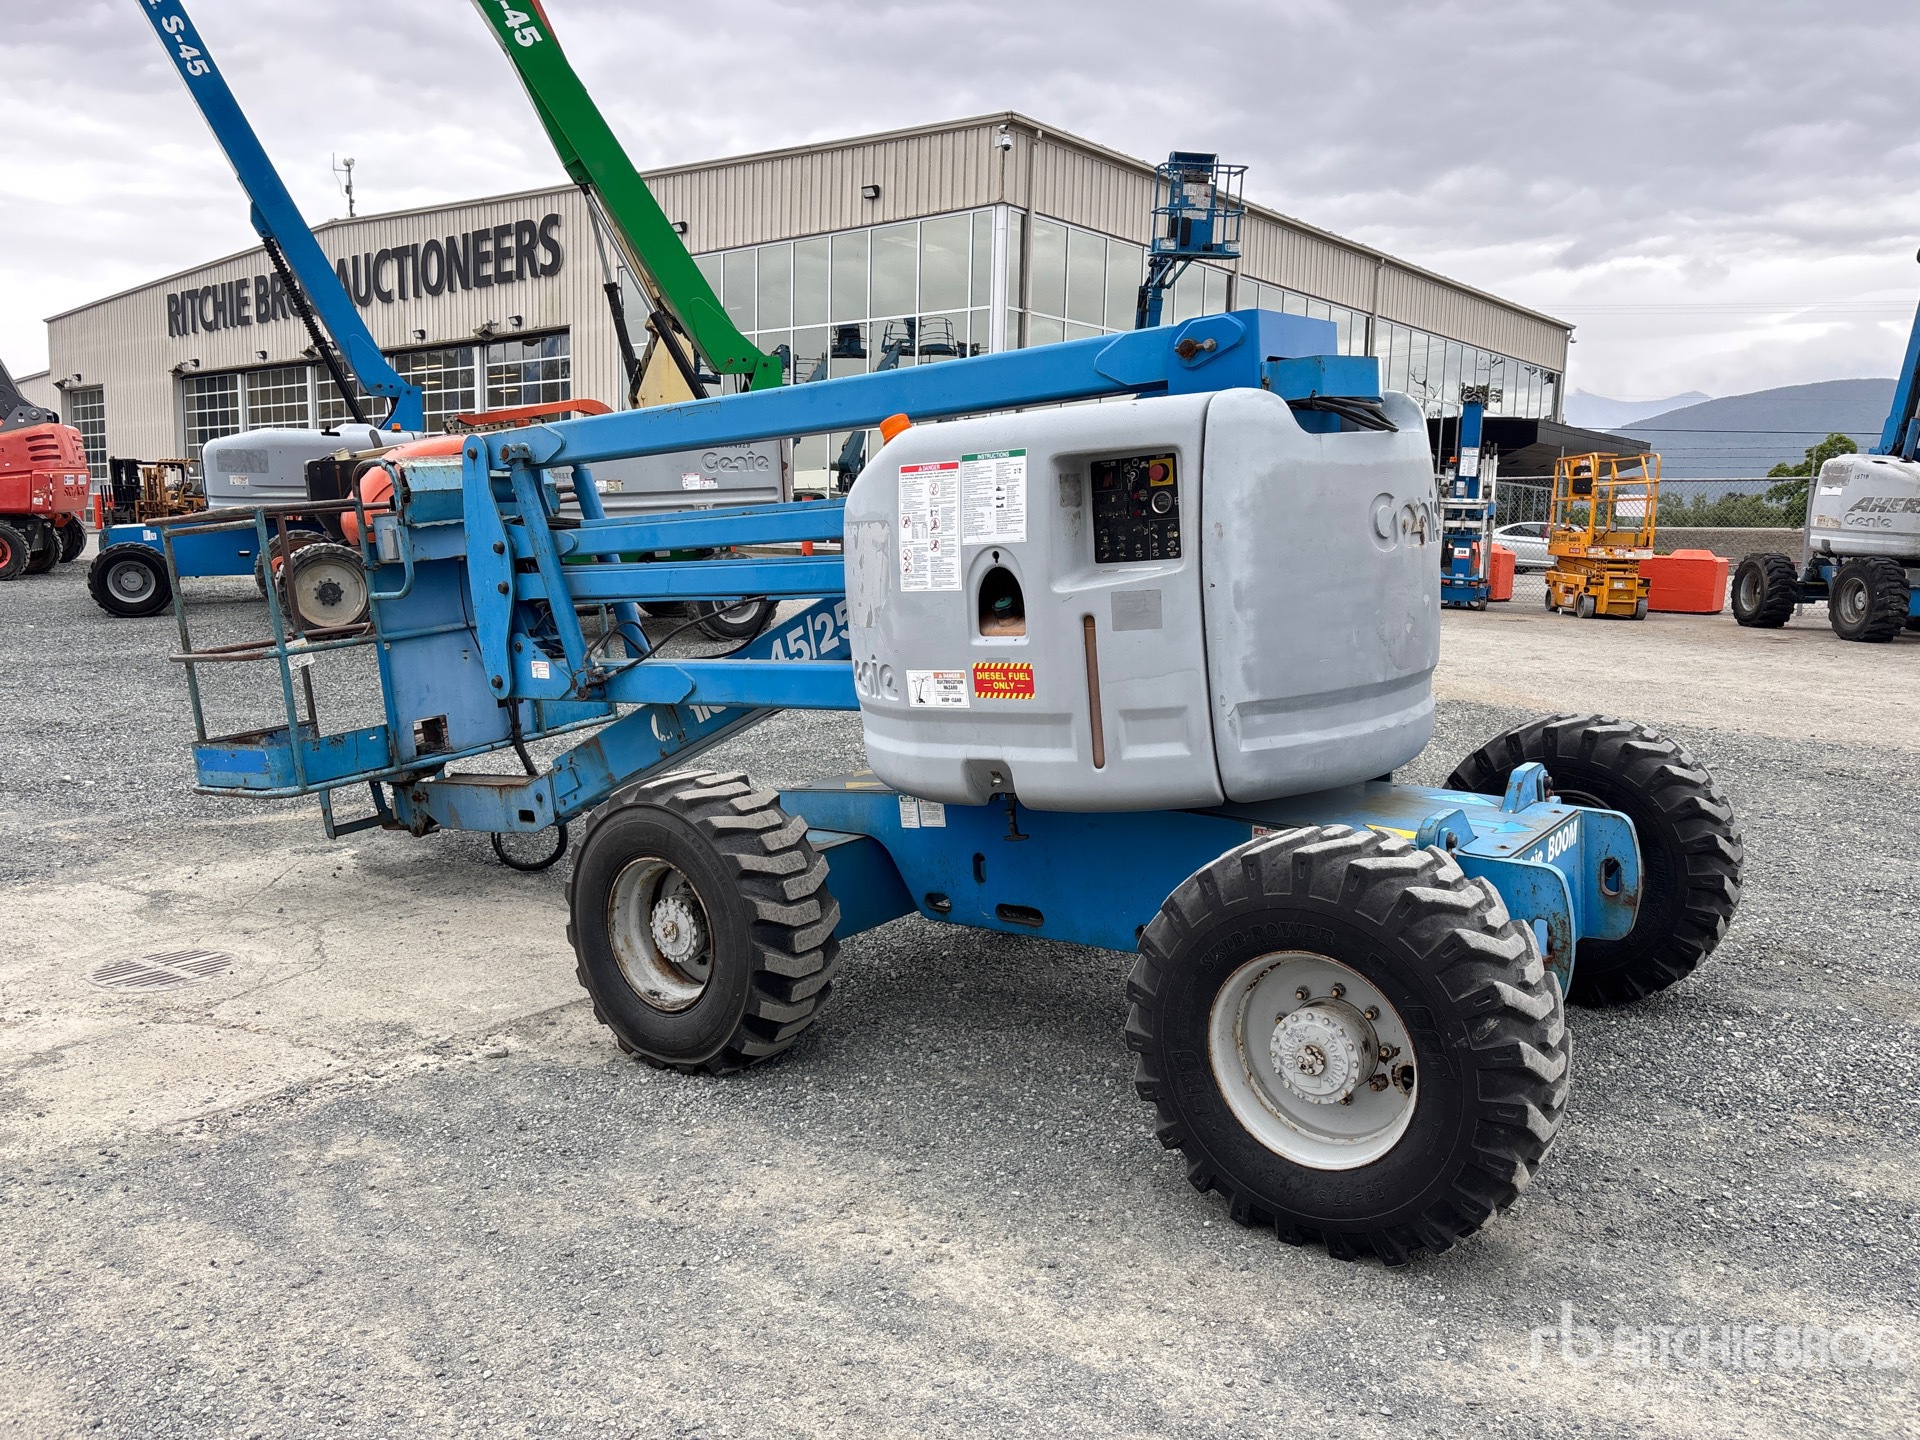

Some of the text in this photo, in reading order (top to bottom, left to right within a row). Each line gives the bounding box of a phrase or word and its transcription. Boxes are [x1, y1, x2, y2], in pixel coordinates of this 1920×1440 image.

[494, 0, 543, 47] -45
[161, 15, 211, 76] S-45
[167, 278, 252, 337] RITCHIE
[336, 213, 564, 307] AUCTIONEERS
[701, 451, 769, 473] Genie
[977, 451, 1010, 460] INSTRUCTIONS
[922, 464, 940, 472] DANGER
[1844, 512, 1893, 529] Genie
[854, 653, 900, 701] enie
[976, 671, 1031, 680] DIESEL FUEL
[992, 681, 1015, 690] ONLY
[1547, 819, 1578, 863] BOOM
